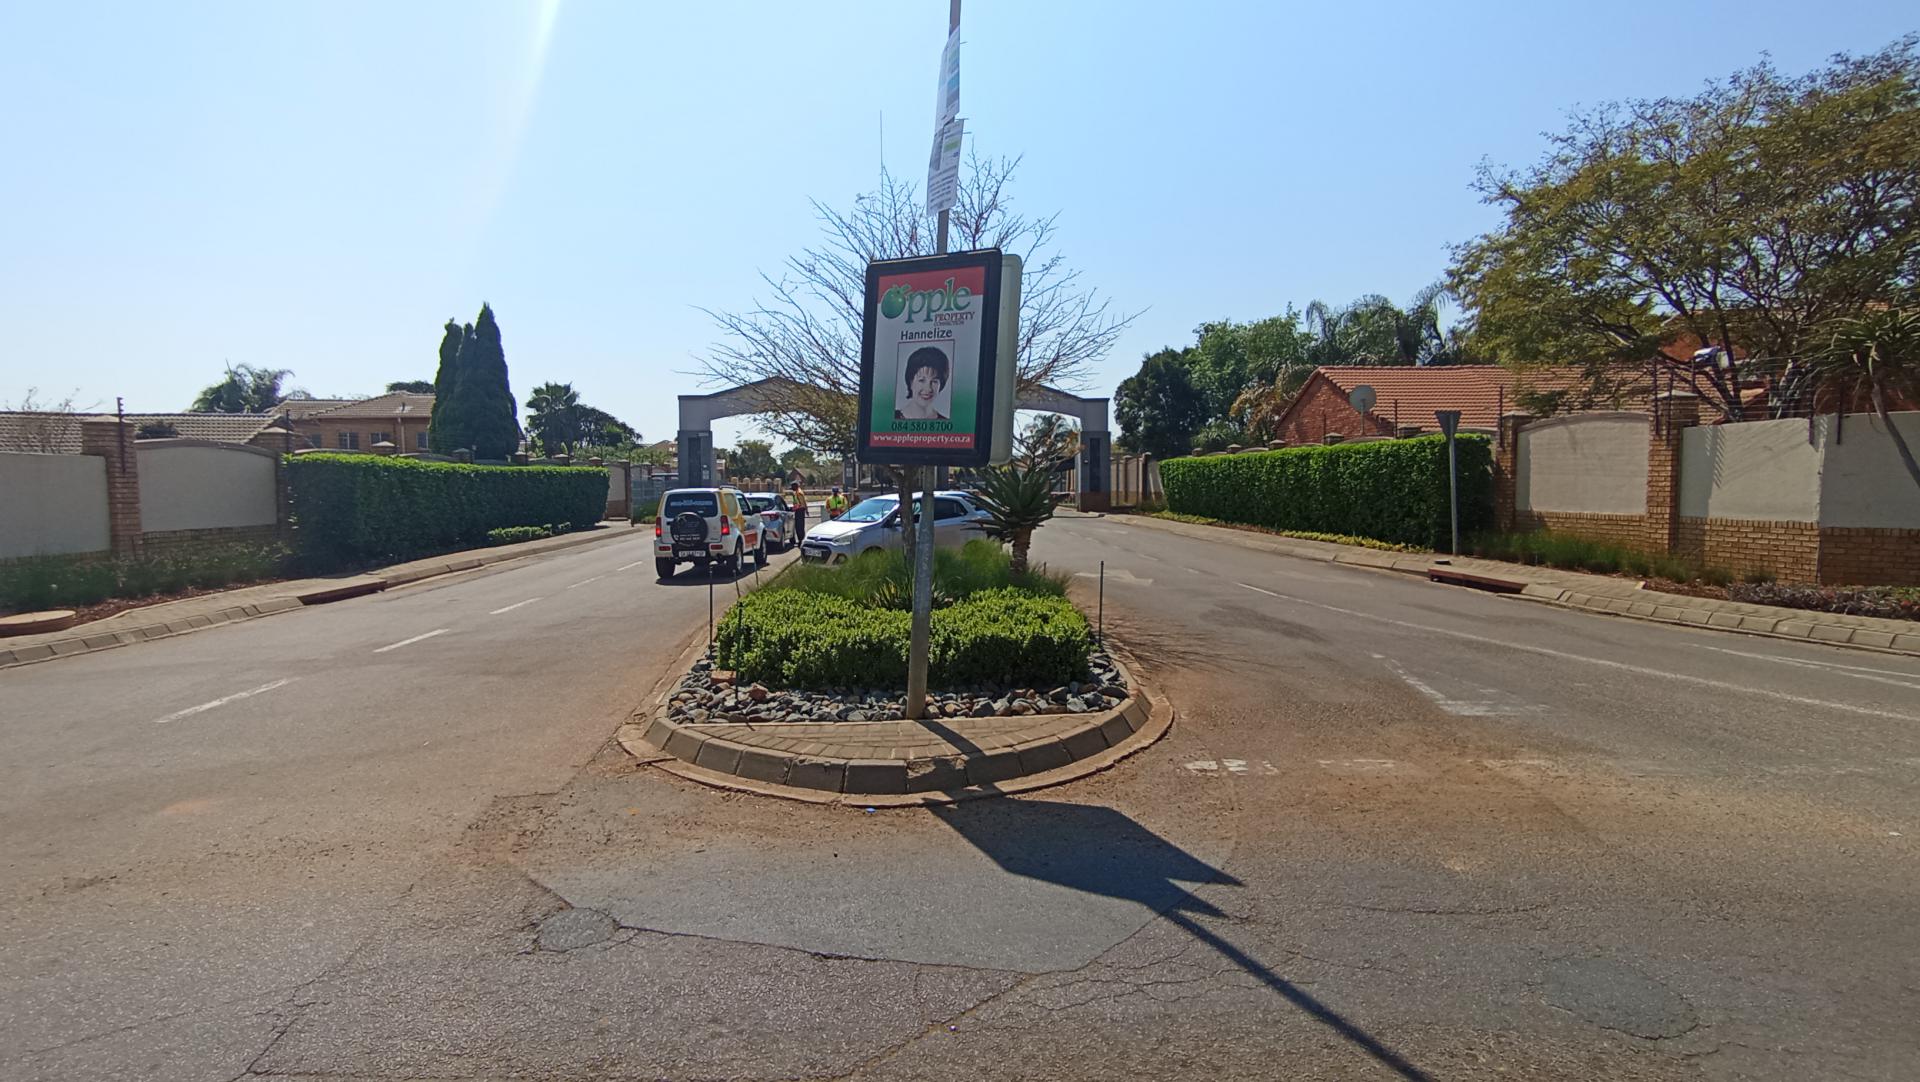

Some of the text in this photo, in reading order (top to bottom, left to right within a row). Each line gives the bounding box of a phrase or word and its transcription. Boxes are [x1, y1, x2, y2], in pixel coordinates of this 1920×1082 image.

[900, 328, 952, 340] Hannelize
[891, 421, 953, 432] 084 580 8700
[873, 433, 971, 444] www.appleproperty.co.za
